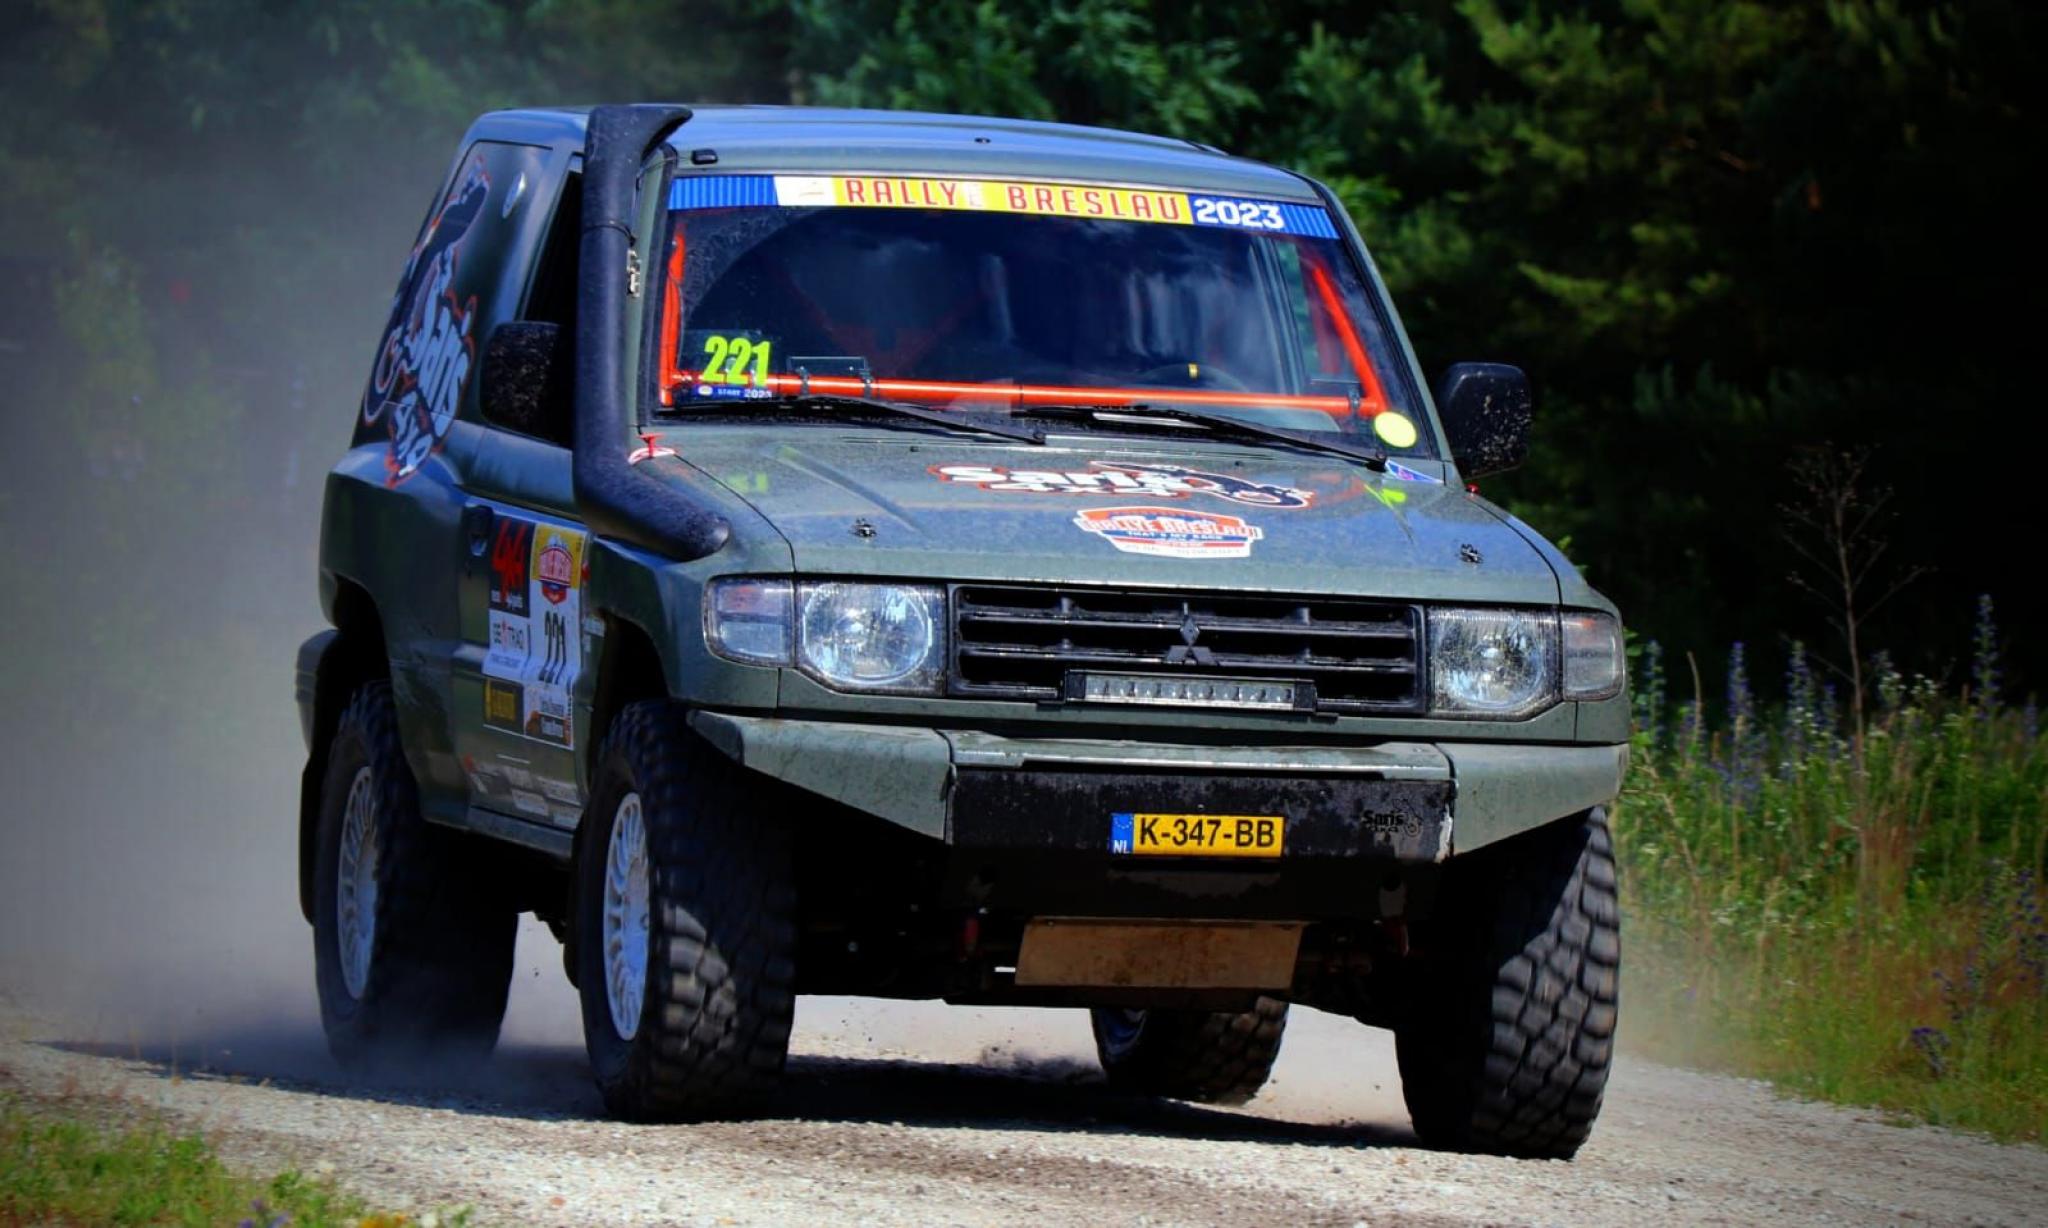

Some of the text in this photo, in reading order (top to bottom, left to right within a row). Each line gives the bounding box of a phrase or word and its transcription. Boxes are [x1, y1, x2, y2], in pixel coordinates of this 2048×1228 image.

[845, 179, 1285, 230] RALLYE BRESLAU 2023
[703, 335, 771, 387] 221
[538, 609, 568, 686] 221
[1113, 839, 1131, 855] NL
[1139, 817, 1275, 848] K-347-BB
